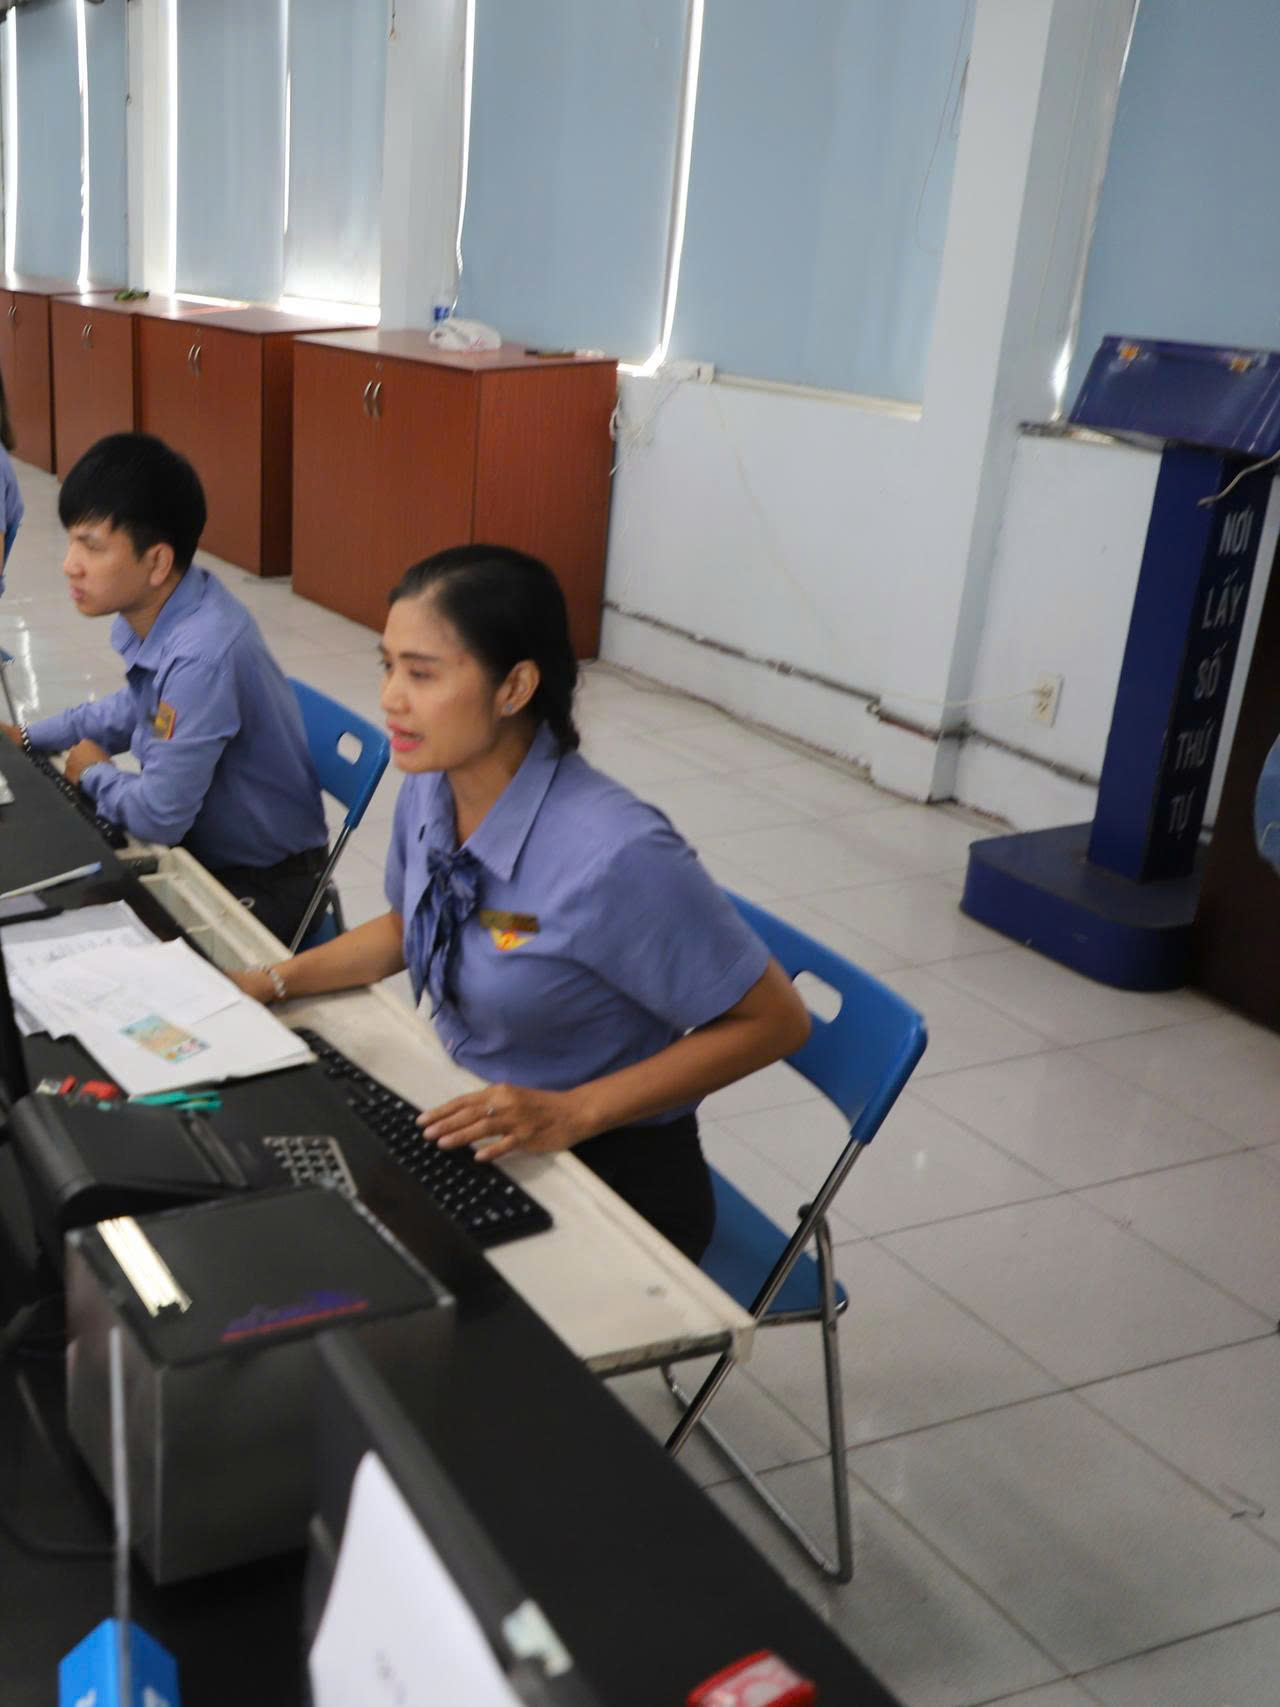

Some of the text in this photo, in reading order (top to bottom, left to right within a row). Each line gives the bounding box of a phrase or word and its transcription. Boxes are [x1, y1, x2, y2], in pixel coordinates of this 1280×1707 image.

[1218, 504, 1254, 556] NƠI
[1202, 567, 1245, 629] LẤY
[1194, 641, 1228, 700] SỐ
[1175, 716, 1216, 770] THỨ
